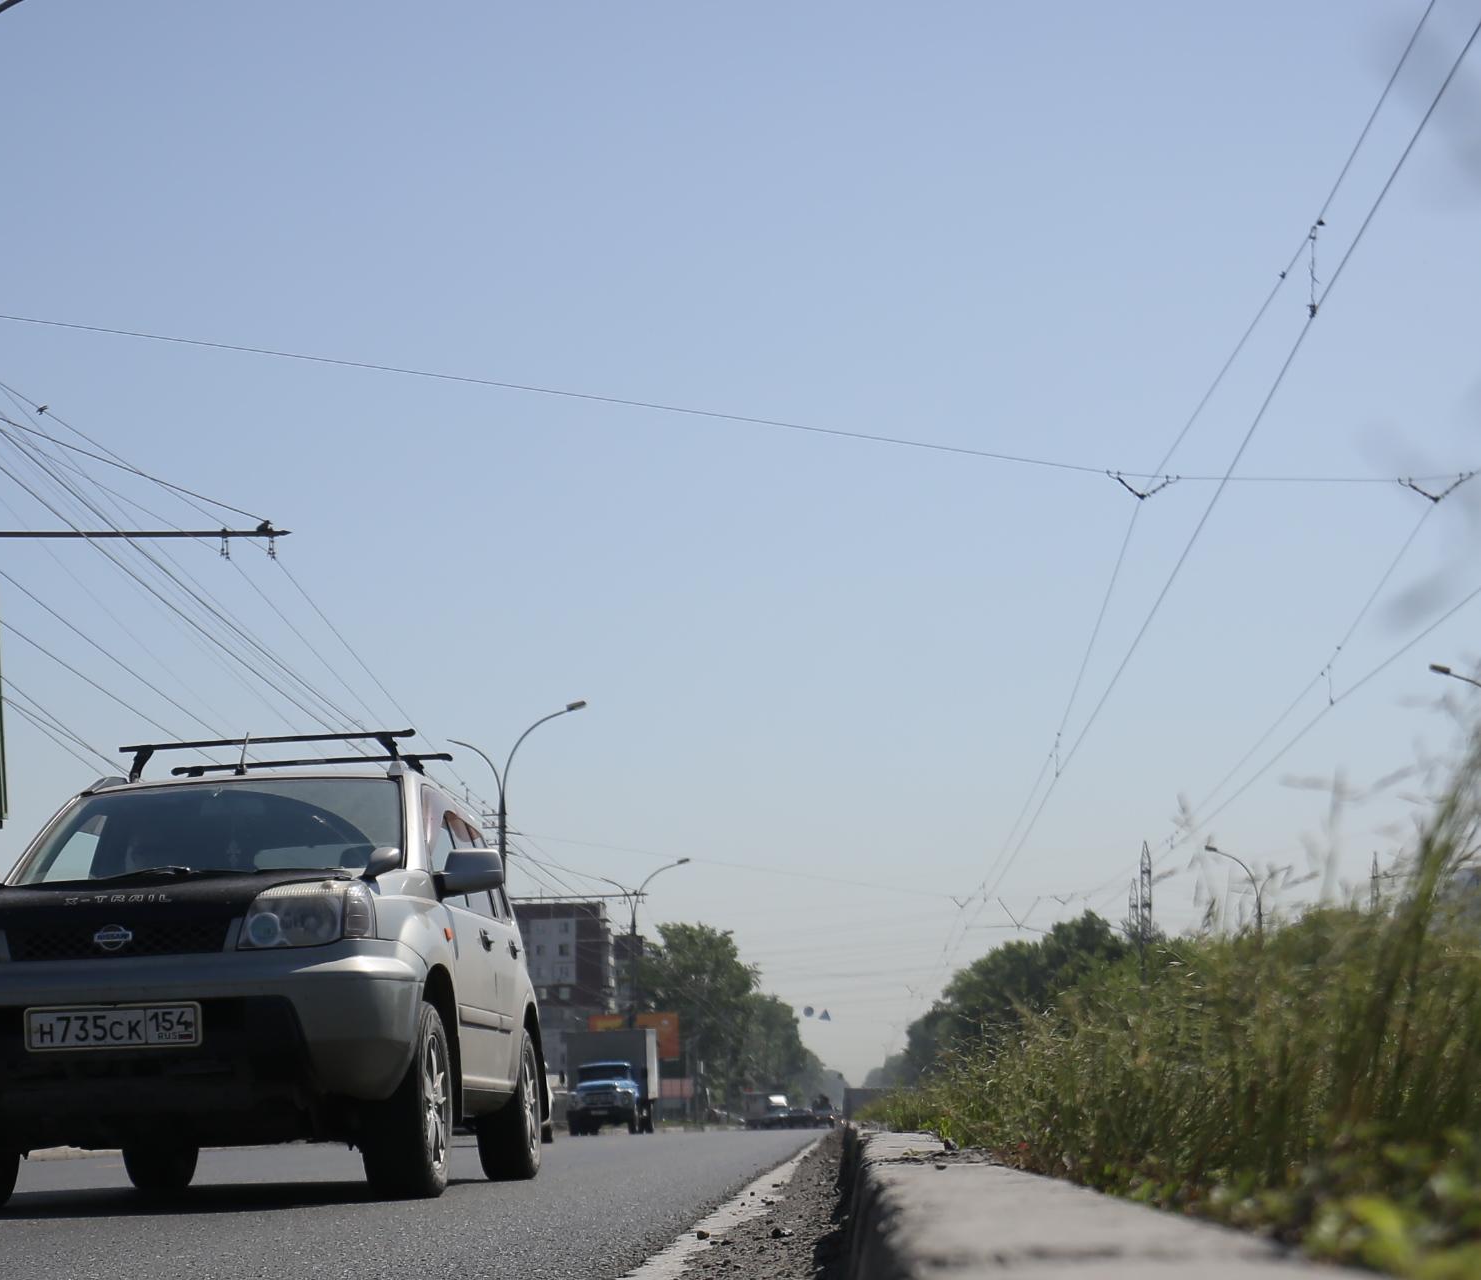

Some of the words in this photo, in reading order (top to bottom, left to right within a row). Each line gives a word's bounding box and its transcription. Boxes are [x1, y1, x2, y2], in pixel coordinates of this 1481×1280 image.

[64, 894, 172, 905] X-TRAIL
[148, 1010, 194, 1032] 154
[157, 1032, 178, 1041] RUS
